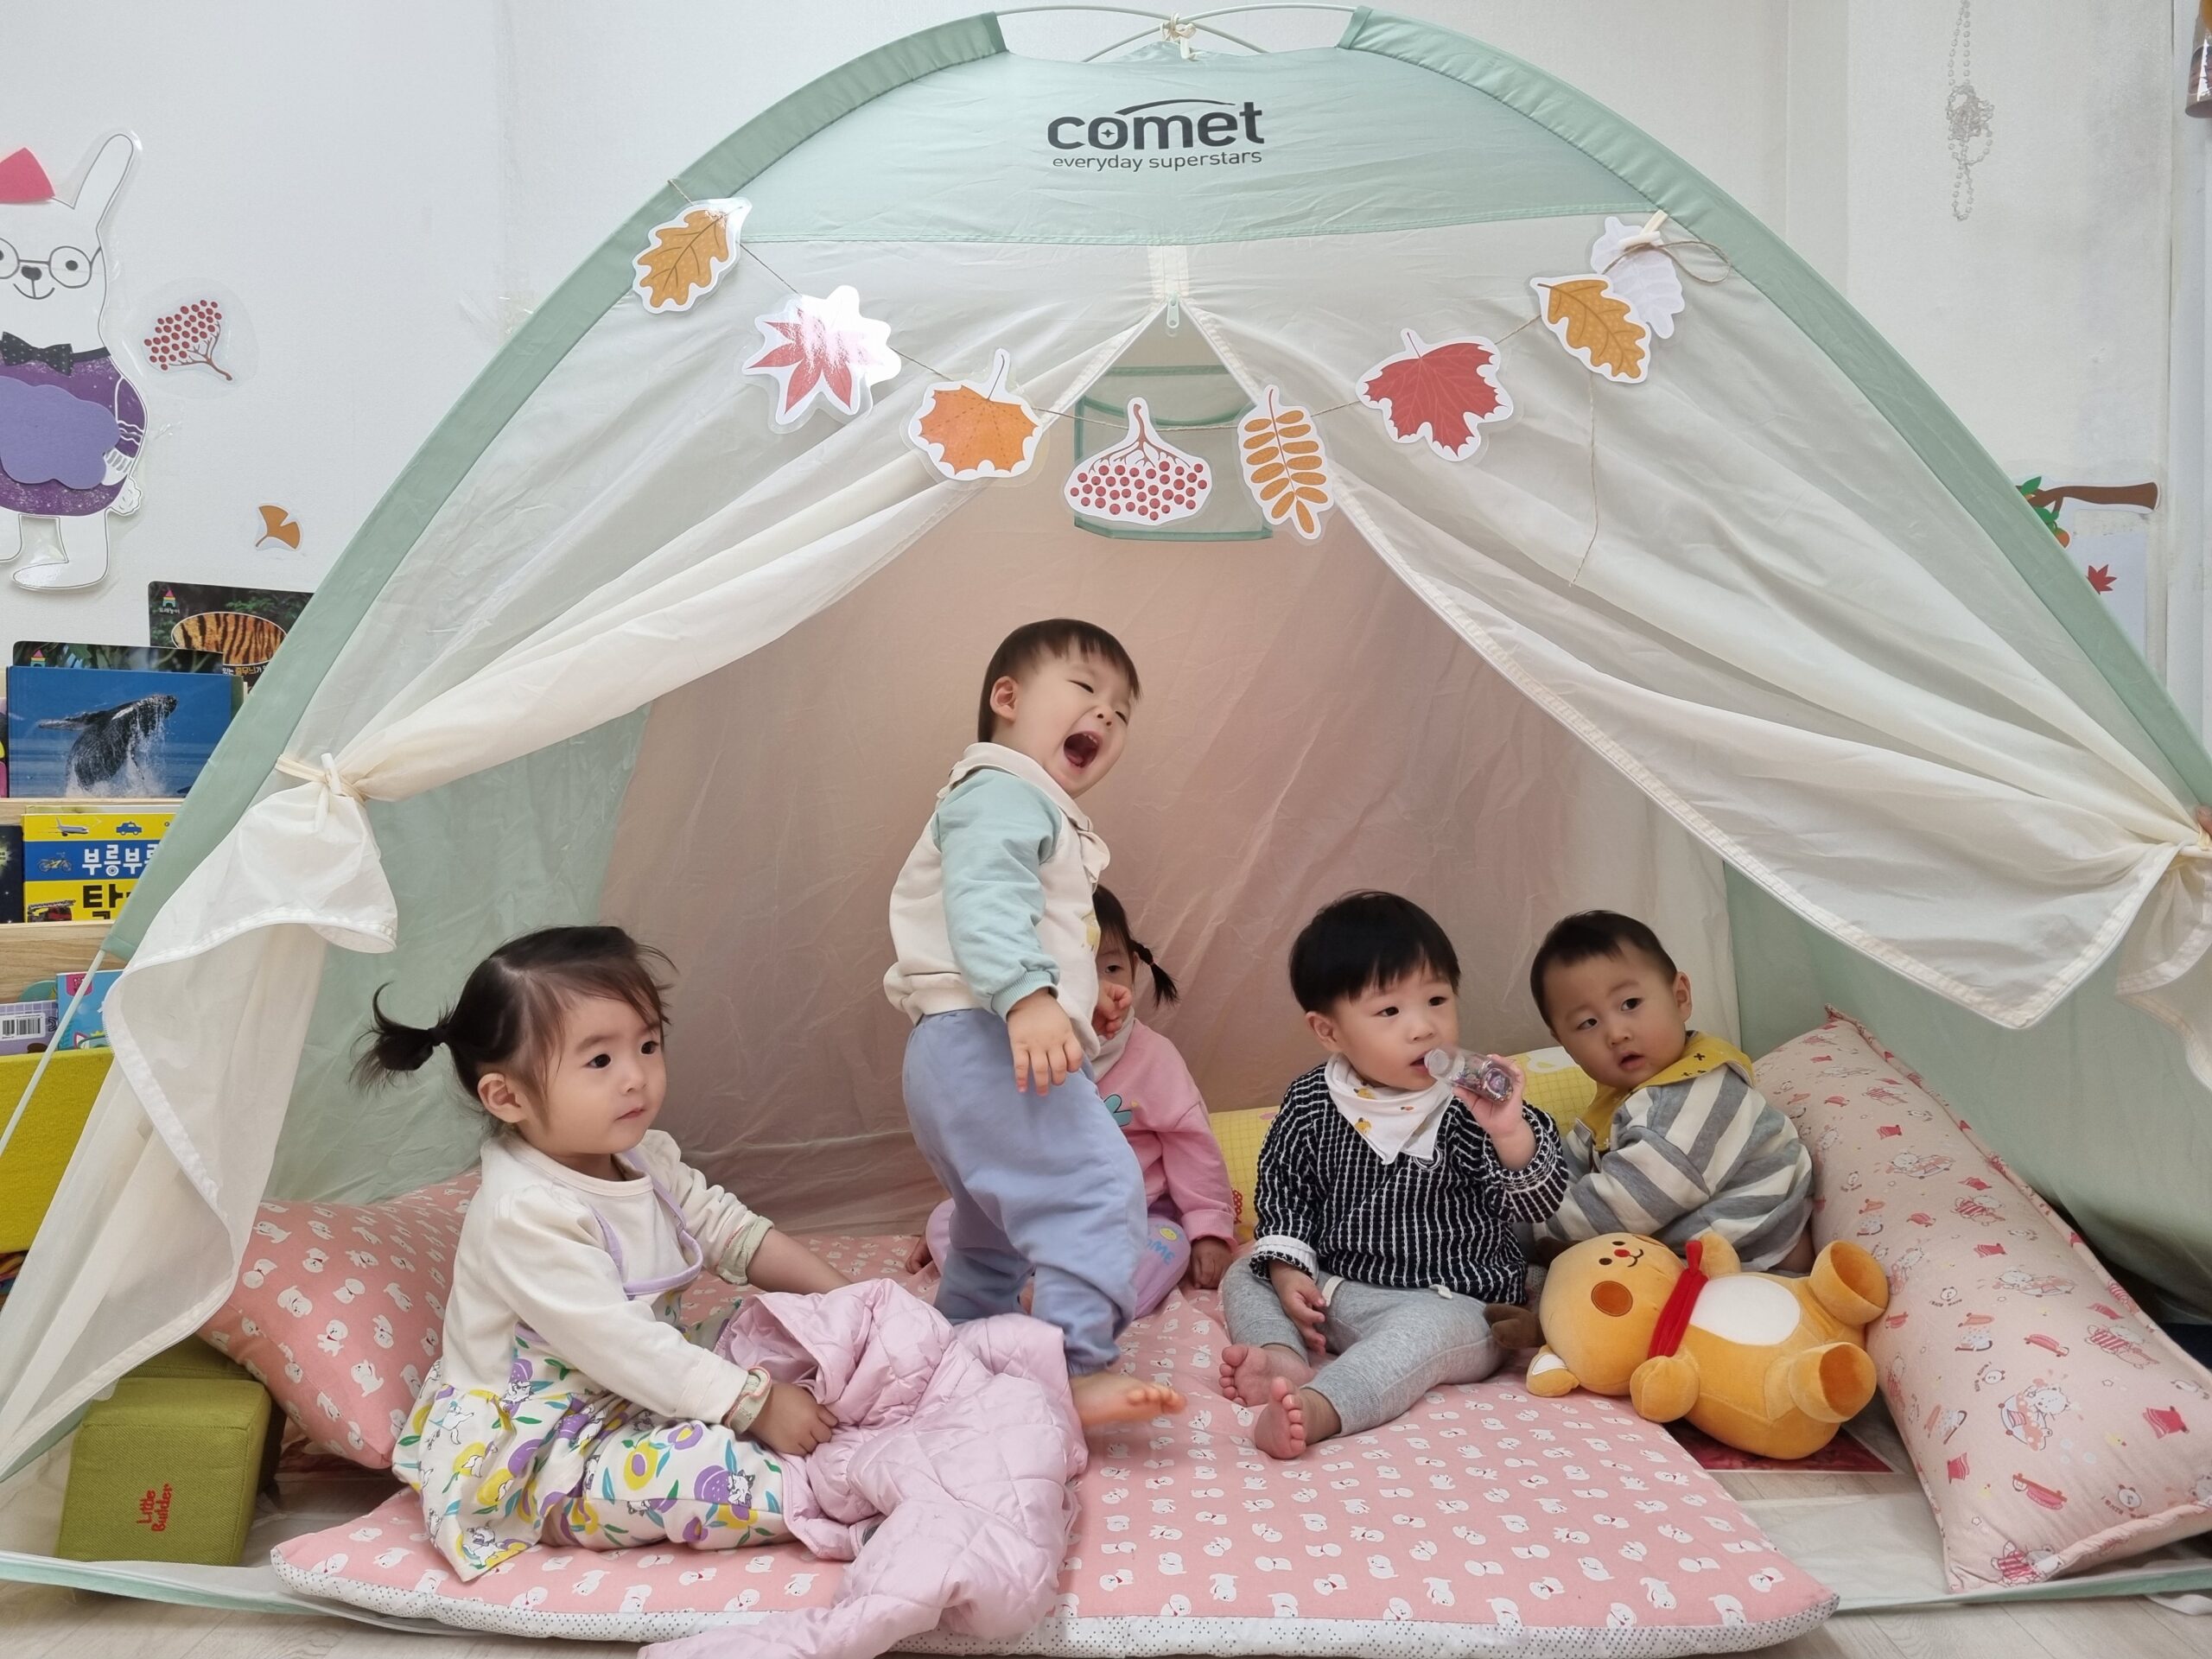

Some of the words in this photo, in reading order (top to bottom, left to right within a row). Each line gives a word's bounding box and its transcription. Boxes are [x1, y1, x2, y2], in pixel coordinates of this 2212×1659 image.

[1048, 99, 1264, 149] comet
[1052, 155, 1143, 172] everyday
[1149, 151, 1262, 171] superstars
[137, 1490, 156, 1523] Little
[151, 1483, 172, 1531] Builder
